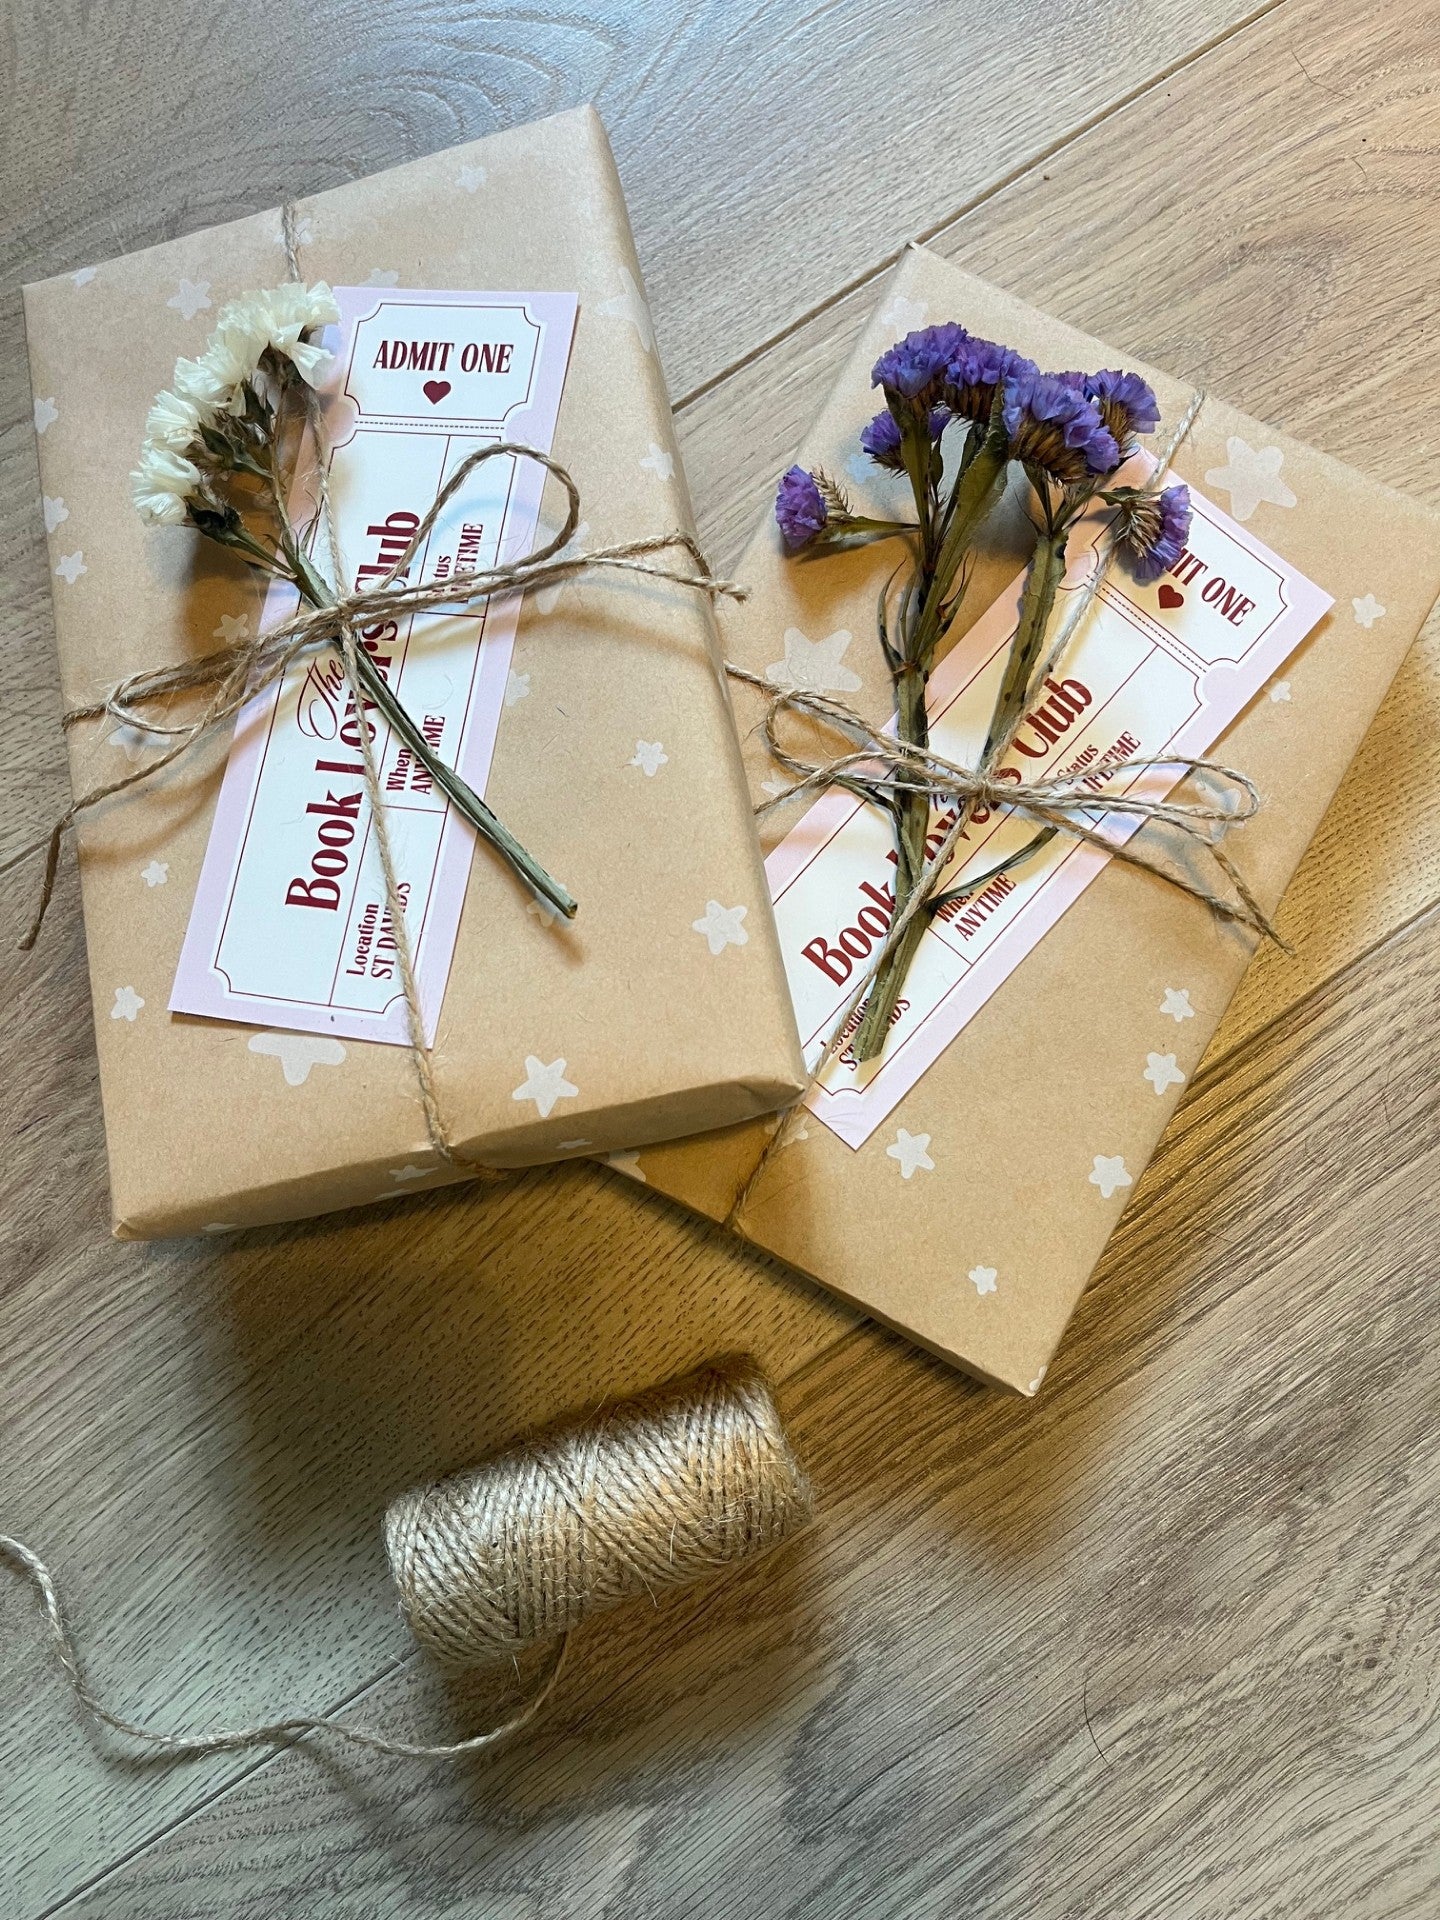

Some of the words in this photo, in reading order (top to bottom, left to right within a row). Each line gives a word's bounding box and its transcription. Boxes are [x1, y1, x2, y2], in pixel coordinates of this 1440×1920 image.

[373, 340, 455, 372] ADMIT
[460, 342, 514, 374] ONE
[1201, 576, 1256, 627] ONE
[296, 656, 346, 741] The
[1010, 677, 1093, 759] Club
[385, 747, 413, 791] When
[284, 789, 365, 912] Book
[346, 903, 379, 976] Location
[954, 871, 1017, 942] ANYTIME
[370, 954, 395, 980] ST
